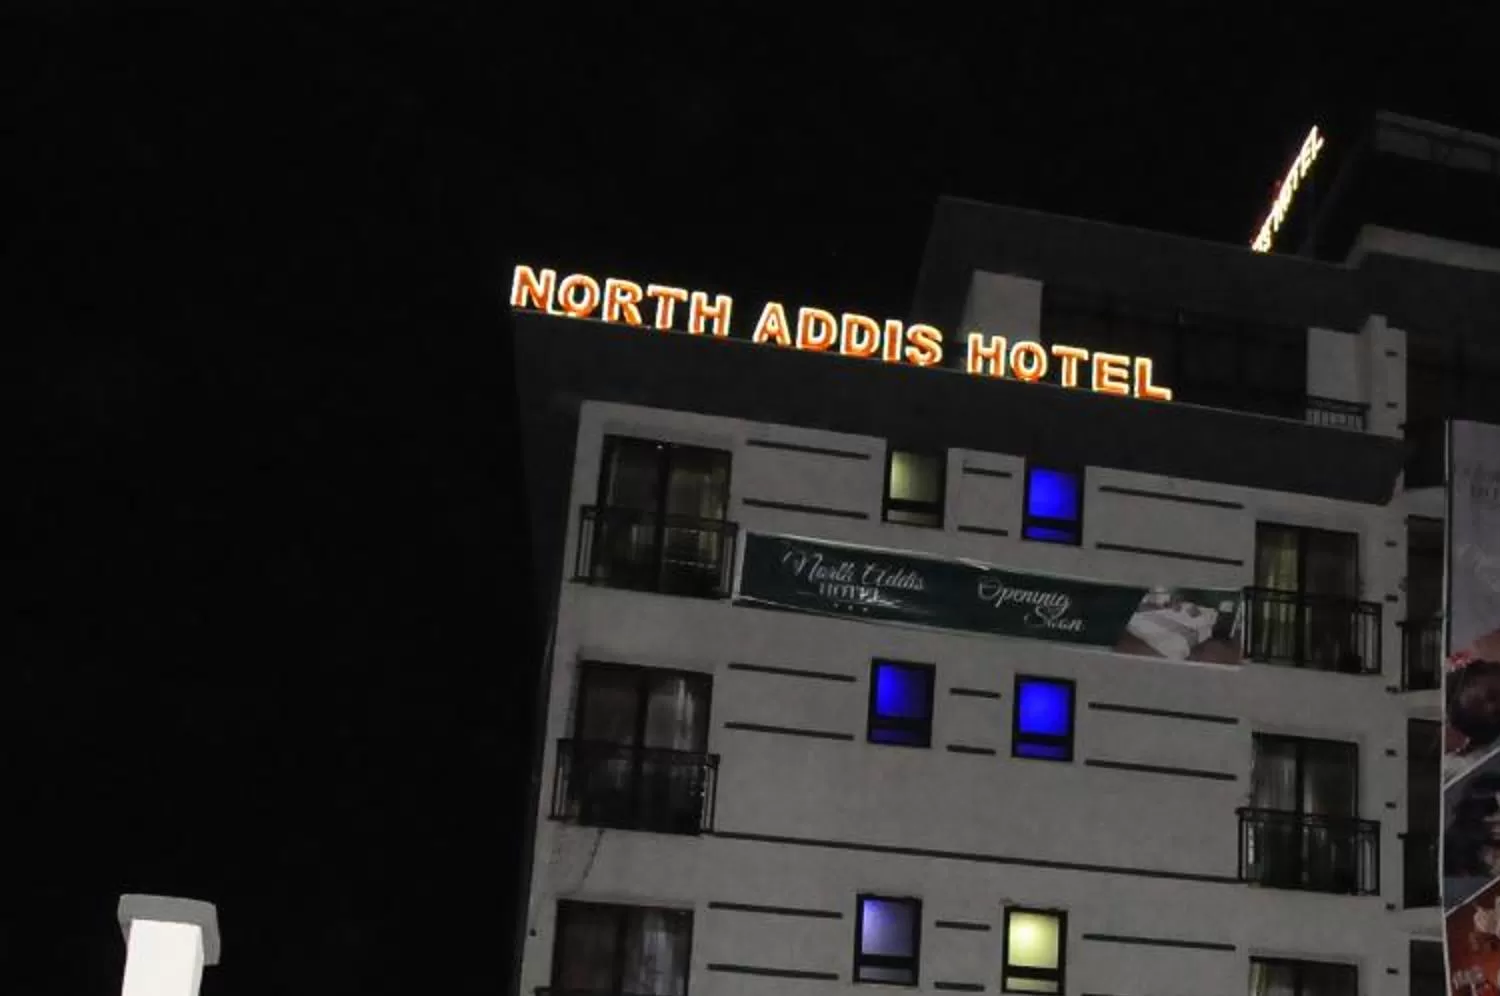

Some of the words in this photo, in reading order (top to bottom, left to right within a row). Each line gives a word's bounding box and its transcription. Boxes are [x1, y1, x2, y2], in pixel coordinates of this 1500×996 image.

[510, 265, 732, 337] NORTH
[752, 302, 943, 367] ADDIS
[966, 332, 1172, 401] HOTEL
